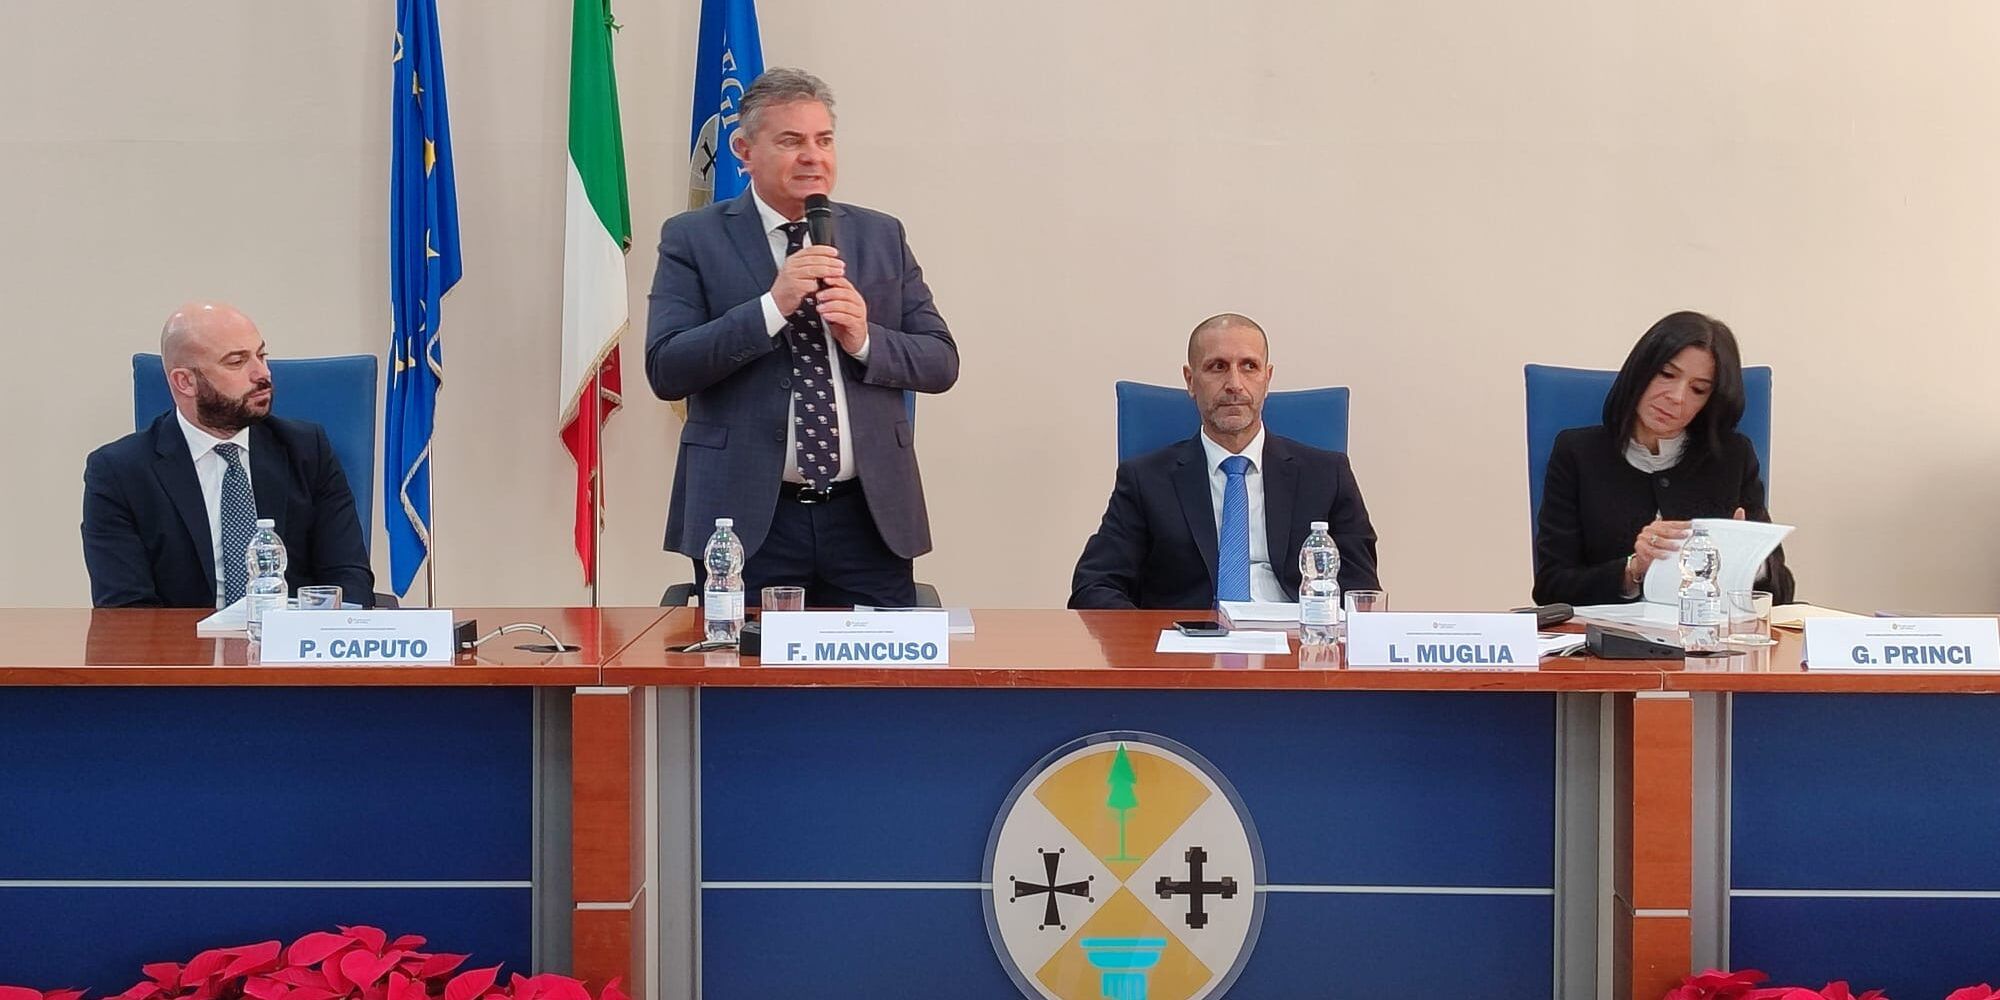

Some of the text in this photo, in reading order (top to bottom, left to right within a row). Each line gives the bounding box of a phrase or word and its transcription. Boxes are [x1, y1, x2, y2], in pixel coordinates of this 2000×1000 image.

[299, 639, 428, 659] P. CAPUTO
[787, 641, 938, 661] F. MANCUSO
[1389, 644, 1514, 664] L. MUGLIA
[1851, 645, 1972, 665] G. PRINCI
